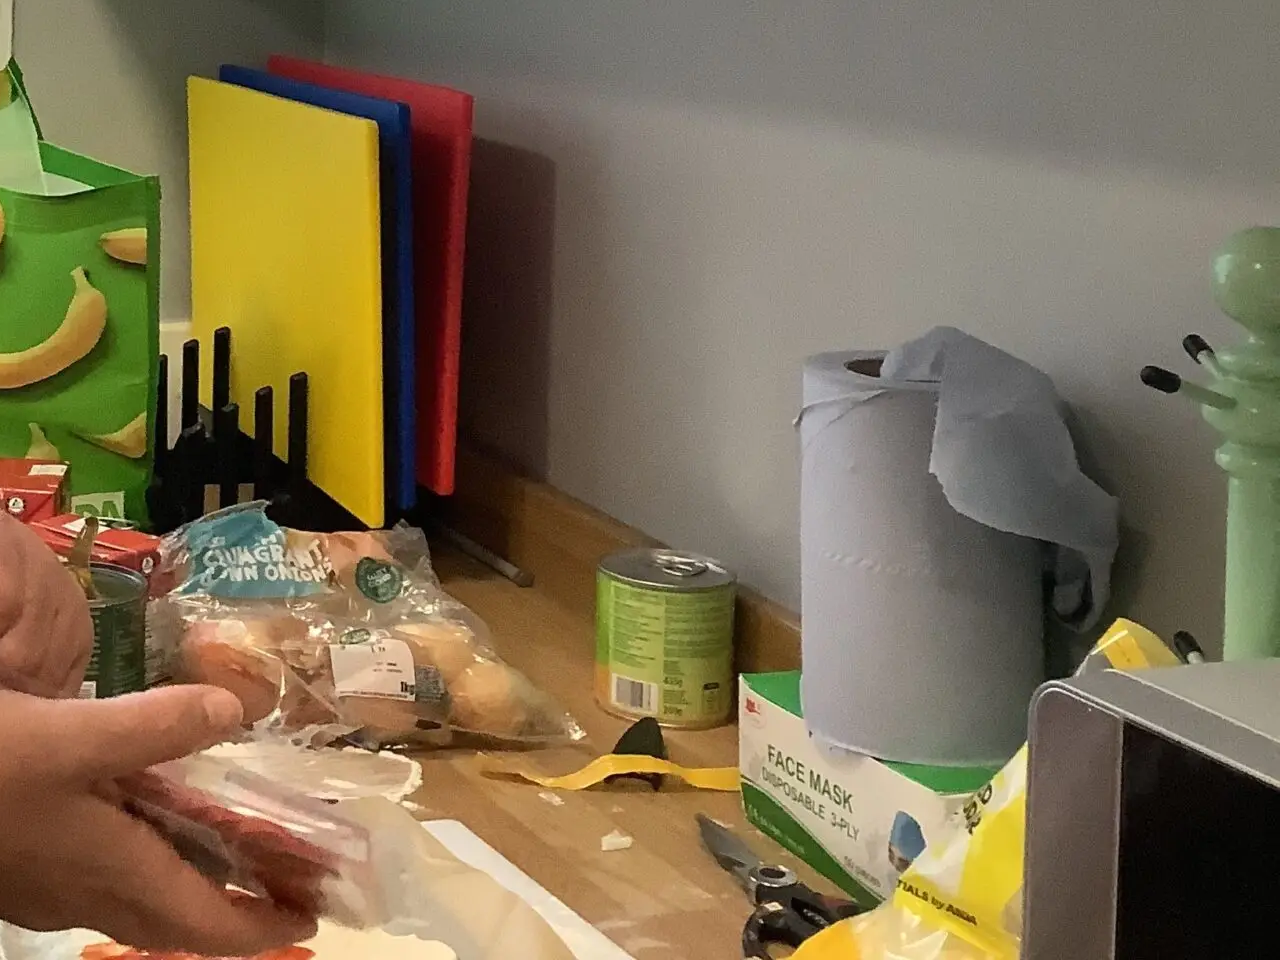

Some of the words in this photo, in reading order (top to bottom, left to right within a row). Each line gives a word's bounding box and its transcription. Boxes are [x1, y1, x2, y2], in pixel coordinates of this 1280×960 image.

[762, 766, 826, 821] DISPOSABLE
[830, 811, 860, 843] 3-PLY
[767, 743, 806, 784] FACE
[809, 769, 854, 814] MASK
[930, 895, 945, 910] by
